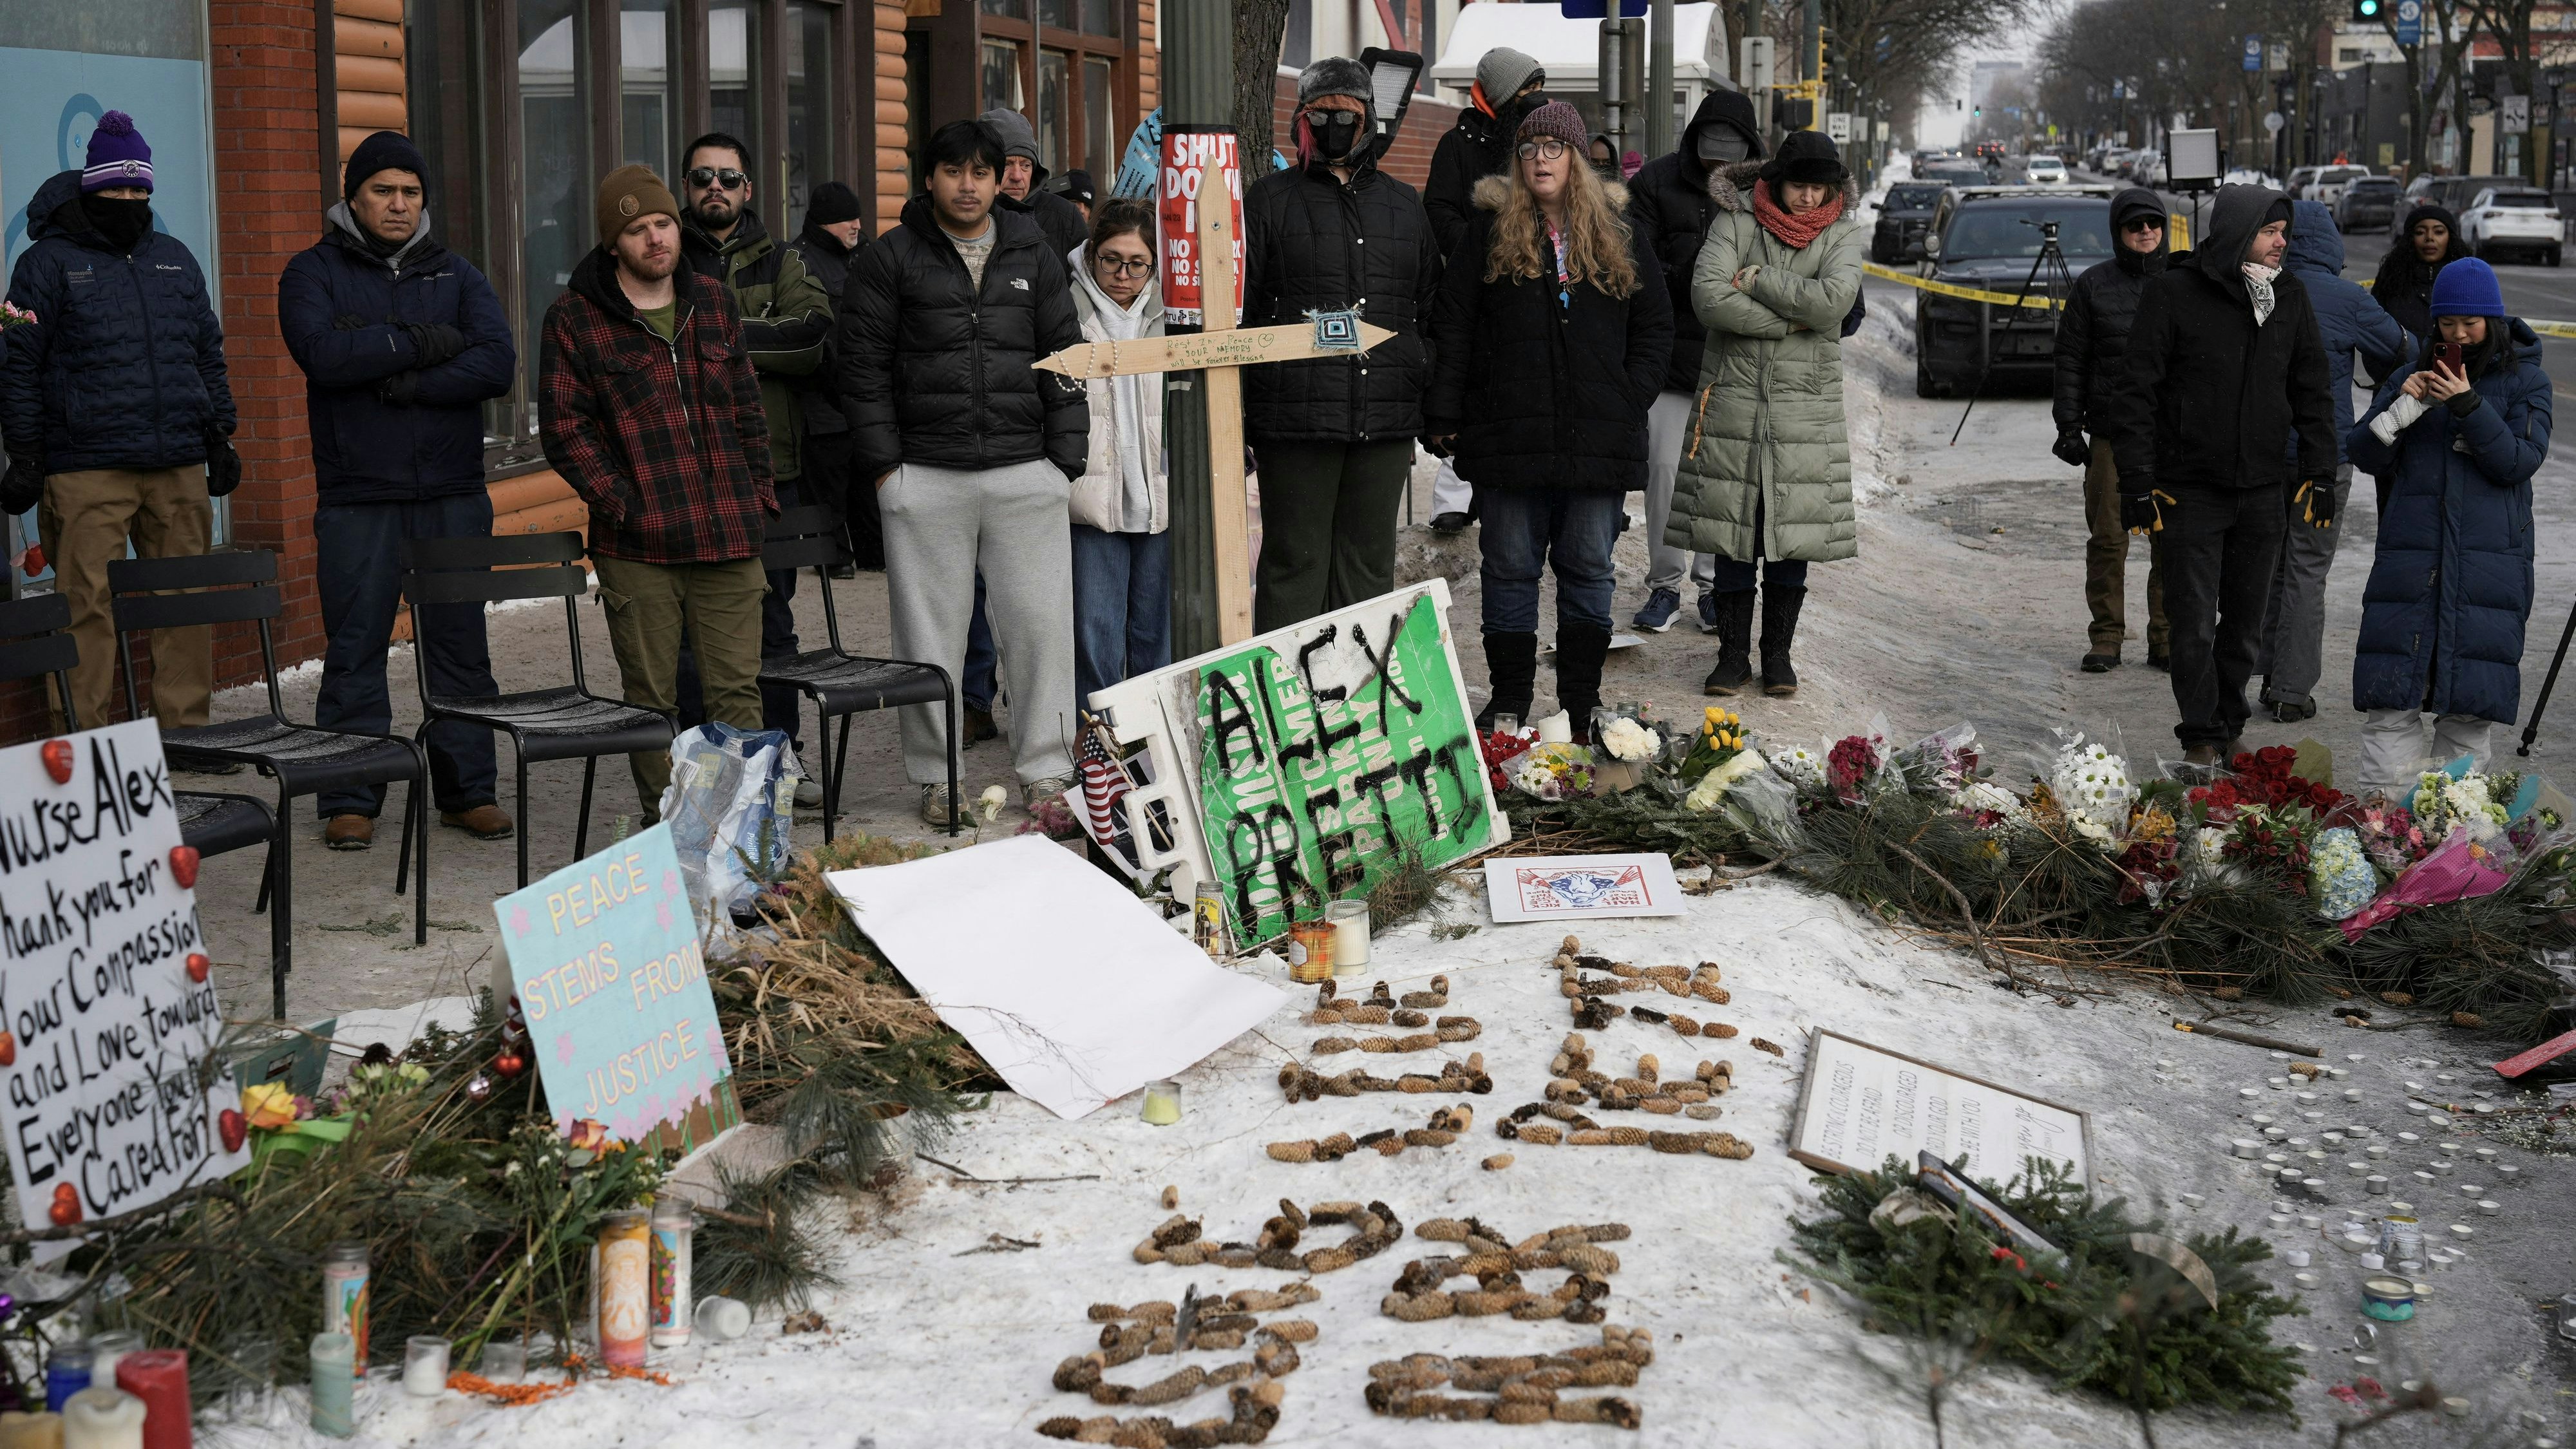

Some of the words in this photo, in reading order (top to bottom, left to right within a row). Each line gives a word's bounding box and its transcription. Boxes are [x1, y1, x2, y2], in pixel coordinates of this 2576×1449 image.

[1173, 133, 1235, 167] SHUT
[1169, 239, 1190, 258] NO
[1171, 259, 1190, 274] NO
[1175, 275, 1189, 286] NO
[1227, 334, 1253, 345] Peace
[1209, 614, 1422, 781] ALEX
[1226, 734, 1482, 938] PRETTI
[546, 851, 649, 936] PEACE
[0, 880, 73, 958] hank
[72, 880, 122, 948] you
[68, 904, 206, 1012] Compassion
[523, 941, 621, 1021] STEMS
[629, 939, 709, 1012] FROM
[10, 1041, 68, 1108] and
[71, 1022, 147, 1086] Love
[140, 984, 221, 1050] toward
[584, 1018, 699, 1115] JUSTICE
[1828, 1061, 1855, 1112] COURAGEOUS
[1863, 1086, 1884, 1117] AFRAID
[1895, 1070, 1918, 1126] DISCOURAGED
[1862, 1113, 1880, 1128] BE
[1930, 1095, 1949, 1117] GOD
[1964, 1097, 1981, 1119] YOU
[18, 1081, 150, 1186] Everyone
[1823, 1113, 1846, 1149] STRONG
[1859, 1123, 1879, 1144] NOT
[1894, 1123, 1911, 1139] OR
[1929, 1113, 1949, 1140] YOUR
[1964, 1115, 1980, 1141] WITH
[82, 1105, 172, 1216] Cared
[1856, 1142, 1876, 1157] DO
[1964, 1138, 1981, 1153] BE
